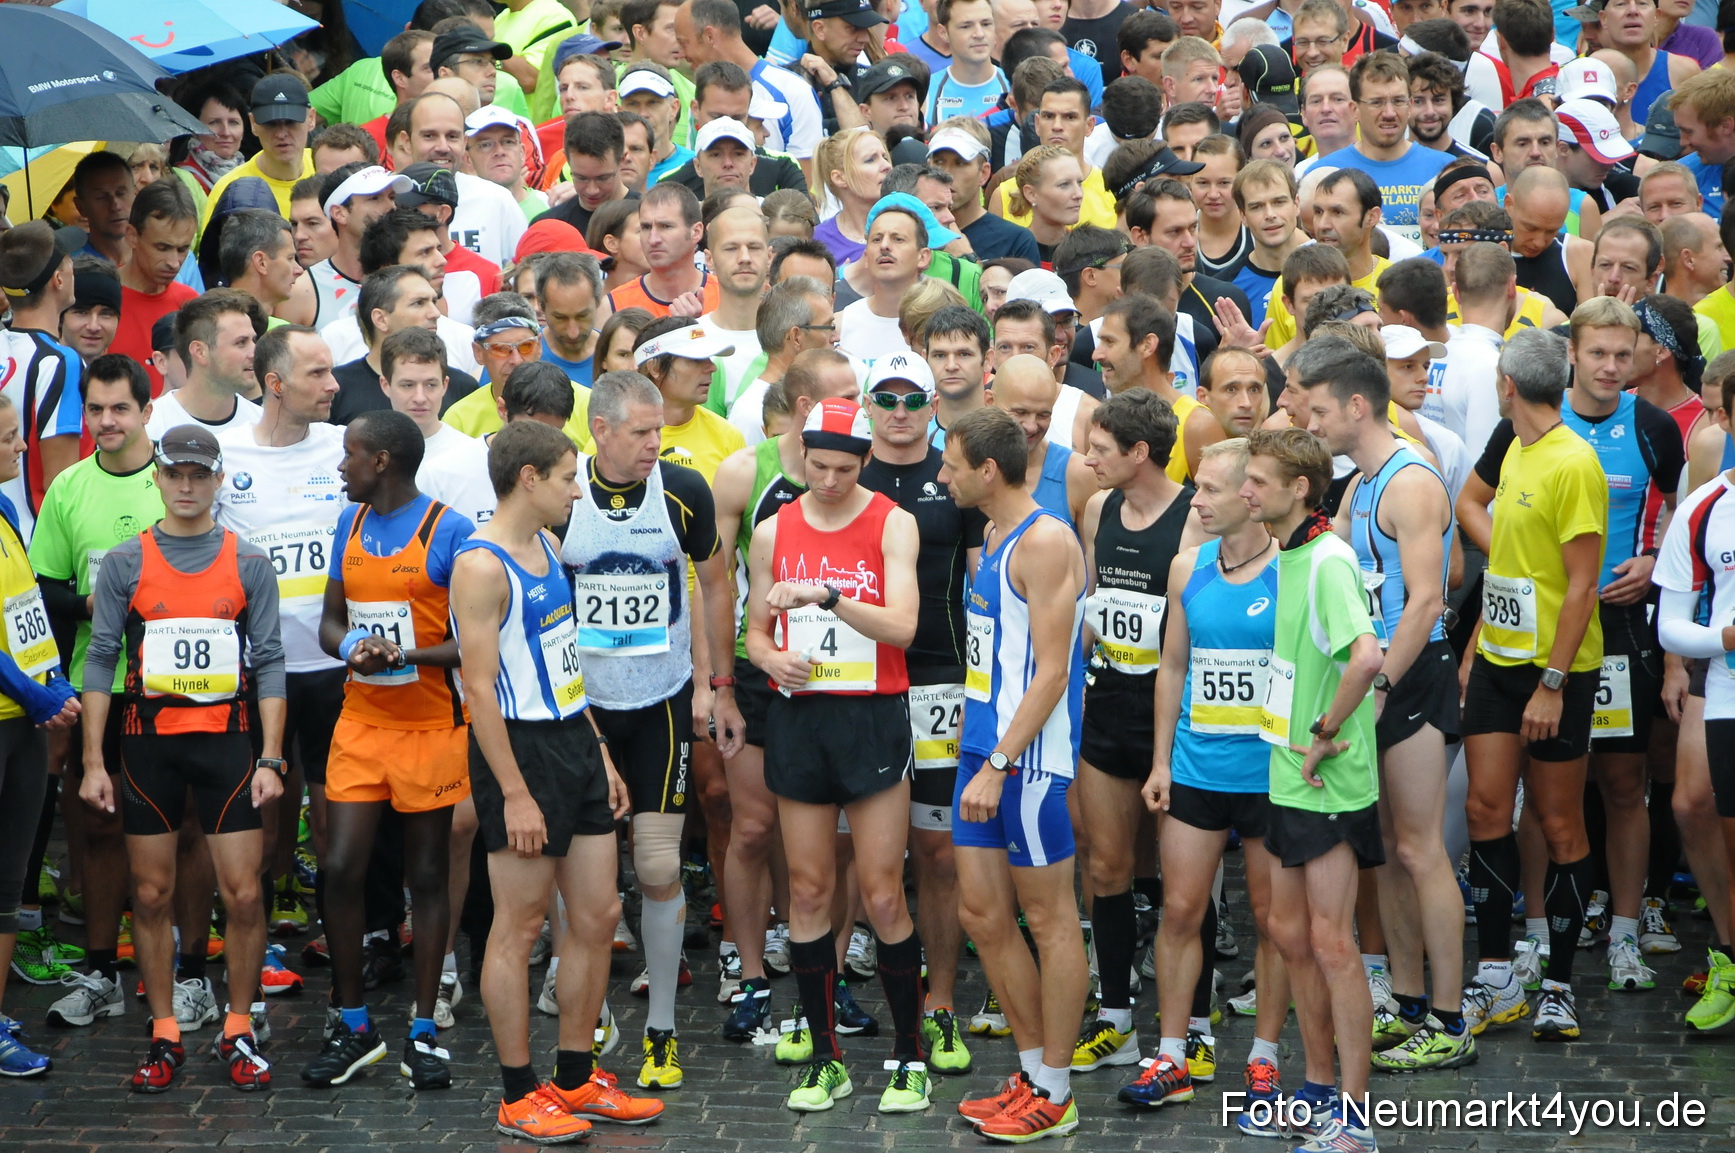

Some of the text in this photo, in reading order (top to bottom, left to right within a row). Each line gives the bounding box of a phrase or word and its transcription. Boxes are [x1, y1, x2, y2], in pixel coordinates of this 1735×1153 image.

[28, 74, 101, 94] BMW Motorsport
[249, 529, 323, 543] PARTL Neumarkt
[630, 527, 663, 535] DIADORA
[269, 541, 326, 576] 578
[400, 565, 420, 573] asics
[1099, 566, 1152, 580] LLC Marathon
[578, 582, 652, 592] PARTL Neumarkt
[814, 576, 858, 589] Staffelstein
[1102, 575, 1148, 590] Regensburg
[1491, 583, 1519, 594] Neumarkt
[586, 594, 660, 626] 2132
[1109, 597, 1148, 610] Neumarkt
[1487, 592, 1521, 626] 539
[358, 611, 394, 619] Neumarkt
[788, 614, 843, 624] PARTL Neum
[14, 606, 46, 644] 586
[147, 627, 220, 636] PARTL Neumarkt
[1097, 606, 1143, 643] 169
[819, 627, 839, 657] 4
[173, 638, 211, 670] 98
[1192, 656, 1255, 667] PARTL Neumarkt
[815, 665, 841, 678] Uwe
[173, 678, 210, 693] Hynek
[1203, 670, 1255, 702] 555
[911, 693, 940, 702] PARTL
[676, 741, 689, 794] SKINS
[444, 780, 462, 792] asics
